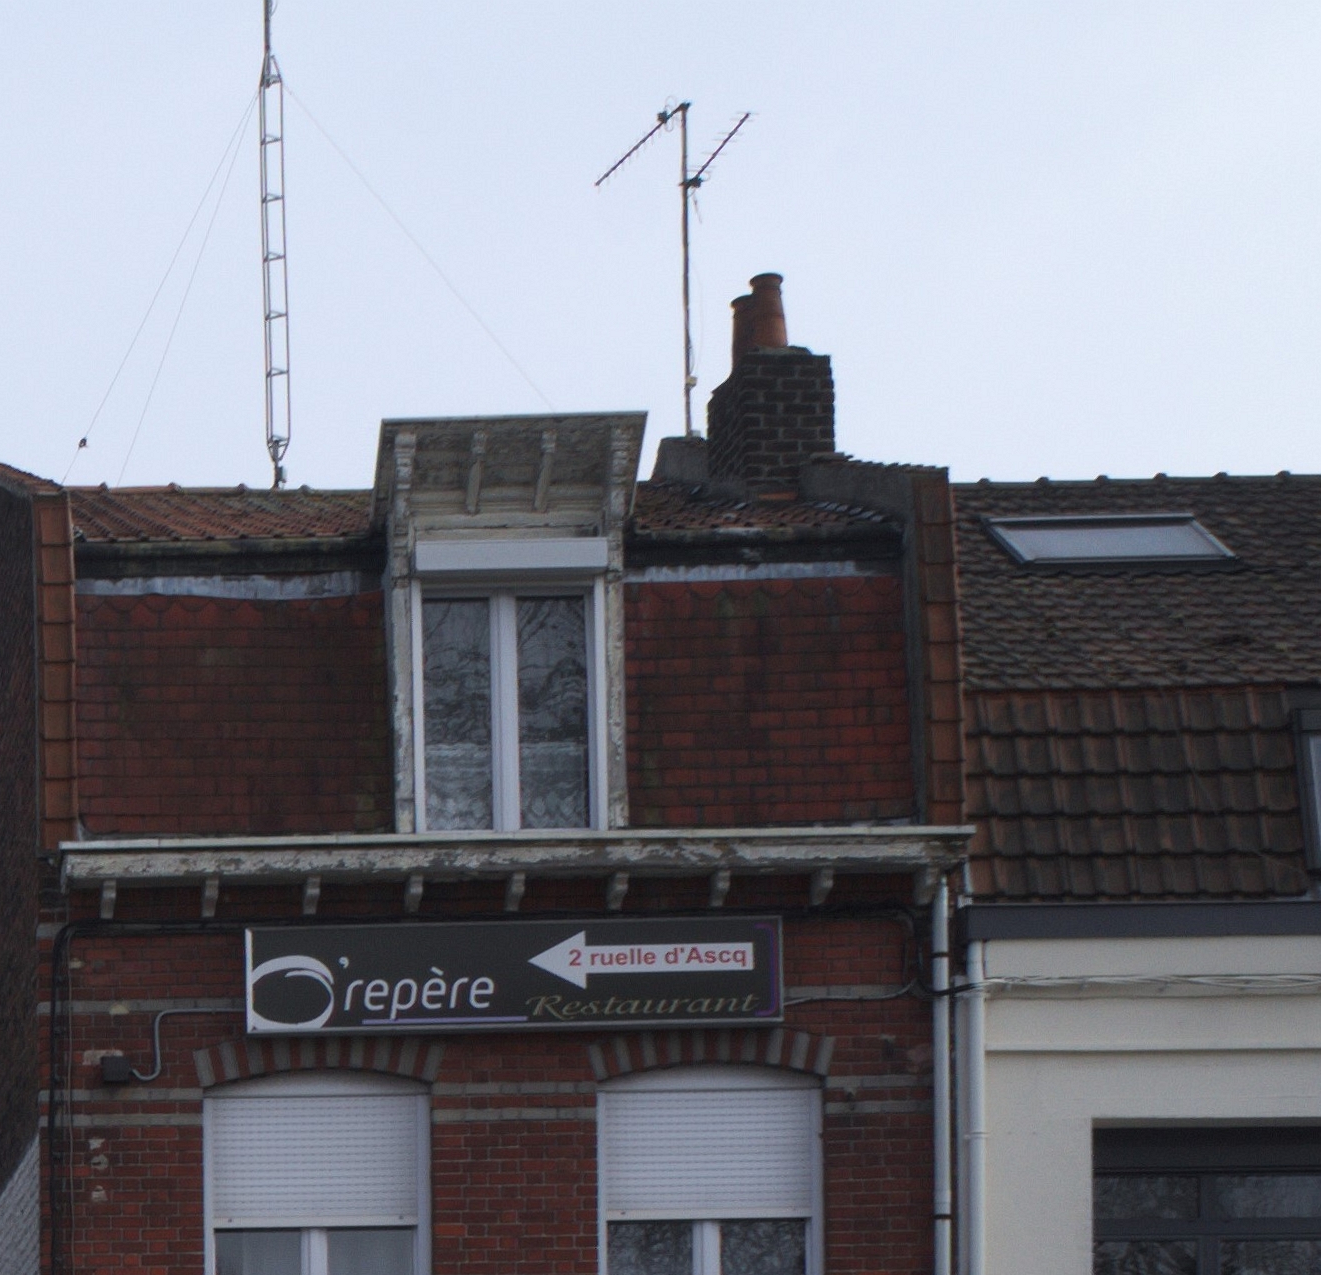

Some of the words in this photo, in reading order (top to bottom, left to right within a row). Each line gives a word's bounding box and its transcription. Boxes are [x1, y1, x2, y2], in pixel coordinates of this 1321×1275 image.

[568, 949, 582, 967] 2
[590, 948, 656, 966] ruelle
[664, 946, 748, 969] d'Ascq
[526, 992, 759, 1020] Restaurant
